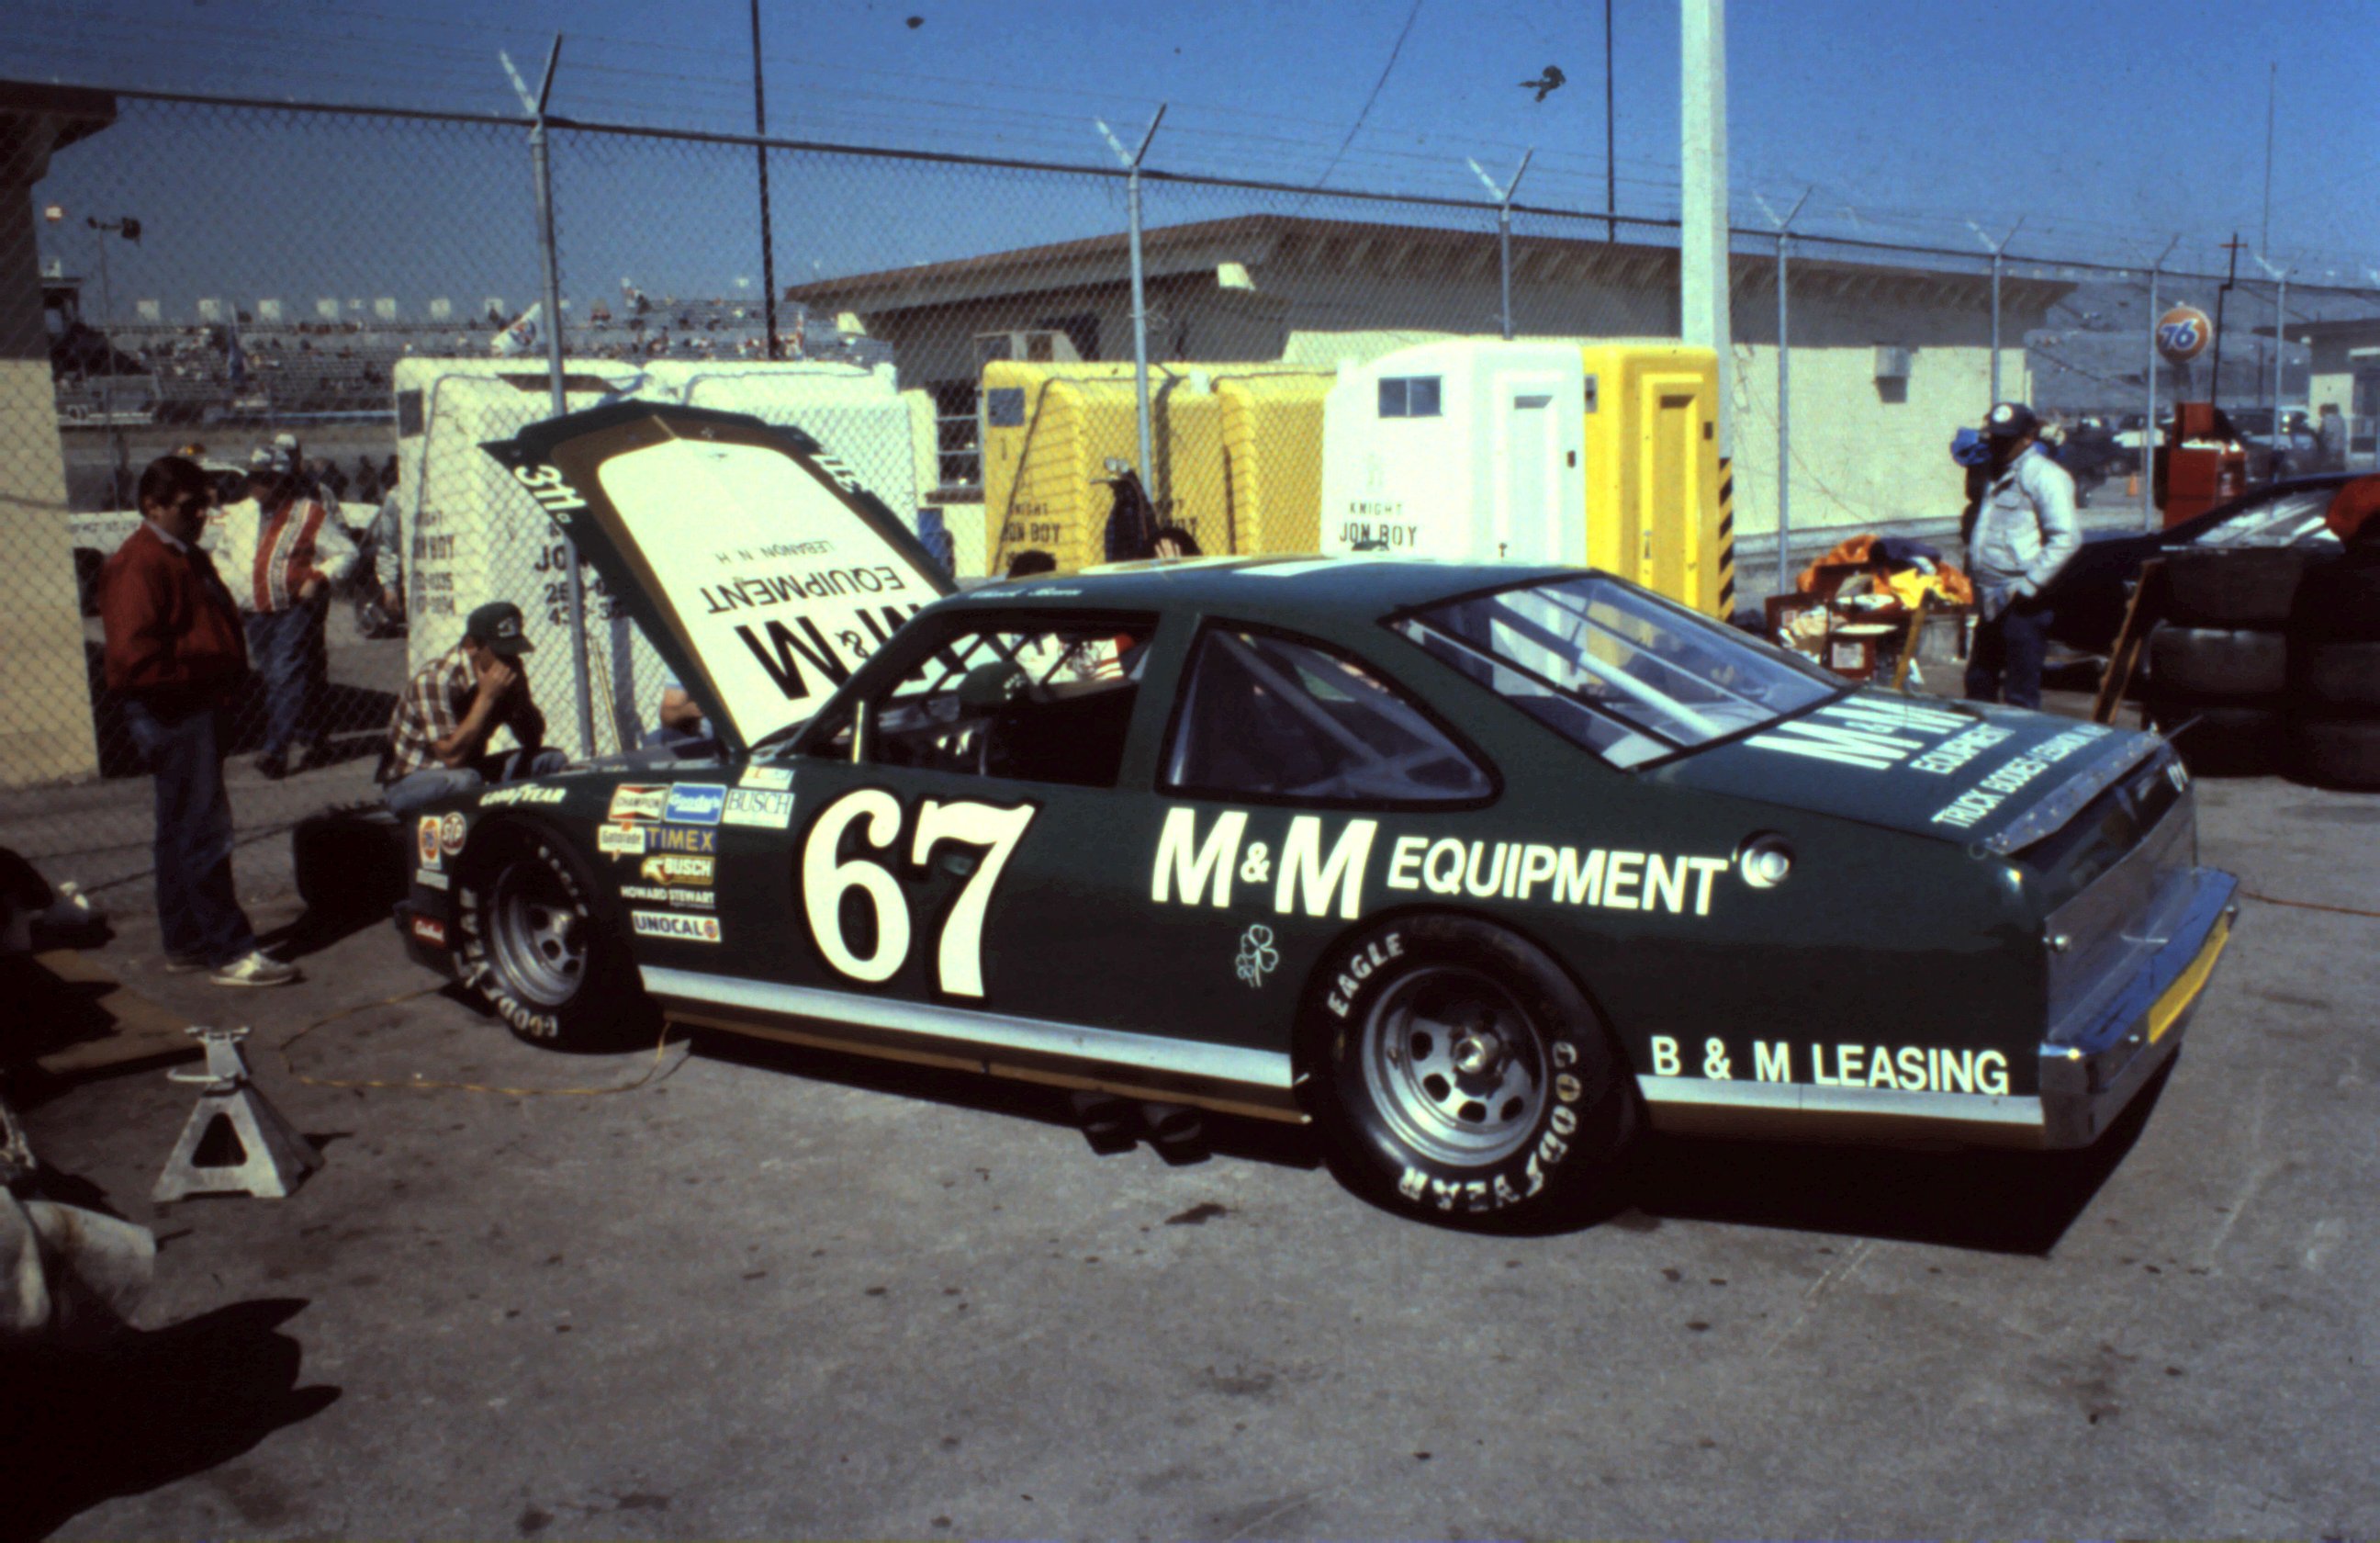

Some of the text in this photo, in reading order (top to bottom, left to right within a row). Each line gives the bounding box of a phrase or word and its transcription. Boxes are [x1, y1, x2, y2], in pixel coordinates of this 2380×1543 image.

[2159, 318, 2199, 351] 76
[514, 464, 588, 511] 311
[1350, 502, 1402, 516] KNIGHT
[1030, 524, 1061, 544] BOY
[1379, 524, 1417, 547] BOY
[761, 540, 836, 558] LEBANON
[699, 566, 906, 614] EQUIPMENT
[1743, 696, 1979, 770] M&M
[613, 795, 660, 809] CHAMPION
[727, 792, 792, 816] BUSCH
[1930, 789, 2006, 828] TRUCK
[646, 827, 714, 852] TIMEX
[663, 857, 713, 877] BUSCH
[1152, 807, 1728, 918] M&M EQUIPMENT
[620, 885, 716, 905] HOWARD STEWART
[803, 788, 1036, 997] 67
[634, 917, 703, 937] UNOCAL
[1327, 931, 1404, 1019] EAGLE
[1651, 1035, 2010, 1096] B & M LEASING
